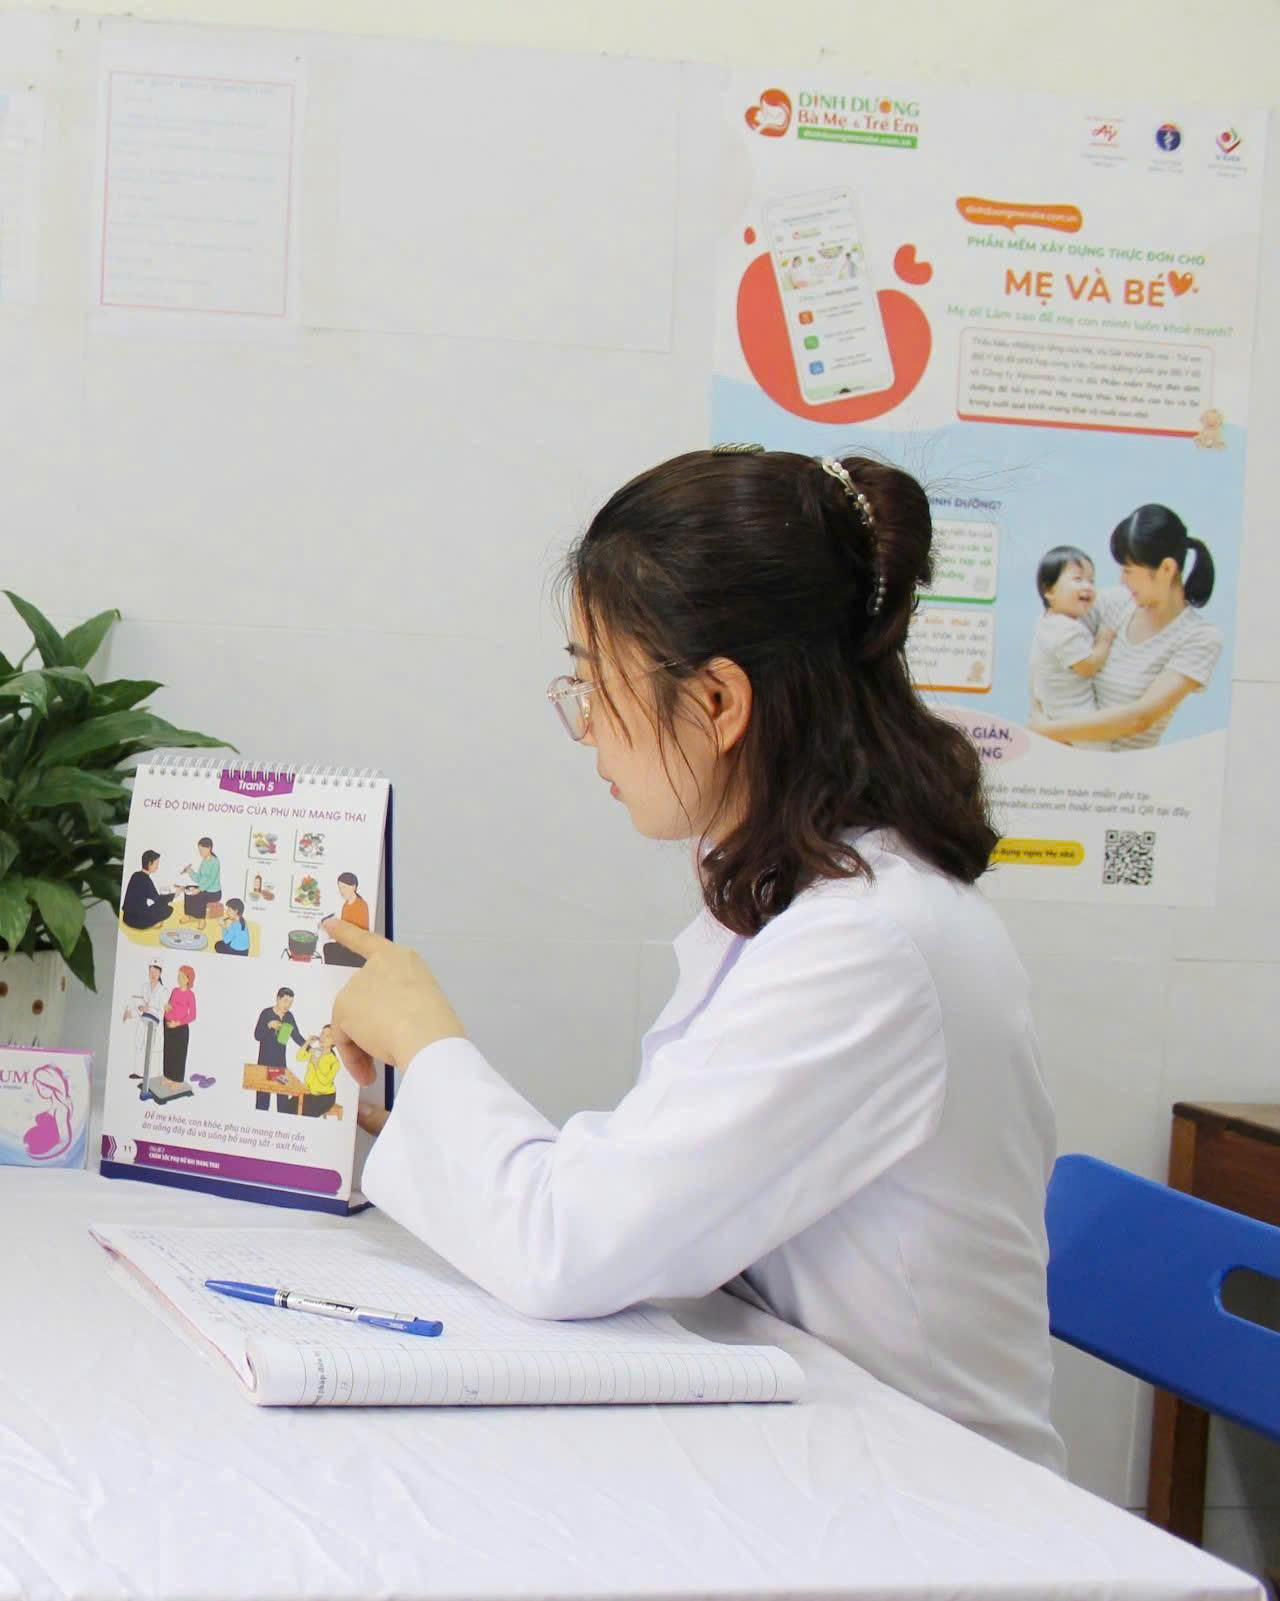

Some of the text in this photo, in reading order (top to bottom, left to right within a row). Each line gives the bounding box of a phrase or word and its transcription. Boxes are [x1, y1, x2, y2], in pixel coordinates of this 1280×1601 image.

[799, 92, 846, 109] DINH
[798, 109, 818, 125] Bà
[823, 112, 847, 129] Mẹ
[894, 118, 919, 134] Em
[1004, 267, 1166, 308] MẸ VÀ BÉ
[238, 779, 274, 791] Tranh 5
[143, 796, 162, 808] CHẾ
[164, 798, 179, 811] ĐỘ
[181, 801, 205, 811] DINH
[207, 801, 244, 814] DƯỠNG
[246, 802, 268, 816] CỦA
[270, 807, 289, 819] PHỤ
[308, 809, 341, 821] MANG
[344, 812, 367, 823] THAI
[152, 1123, 170, 1135] uống
[172, 1125, 185, 1137] đầy
[198, 1129, 207, 1138] và
[207, 1130, 226, 1143] uống
[238, 1136, 257, 1148] sung
[275, 1139, 290, 1149] axit
[291, 1141, 308, 1153] folic
[188, 1118, 201, 1126] con
[224, 1122, 238, 1133] phụ
[251, 1128, 273, 1139] mang
[274, 1128, 290, 1138] thai
[291, 1131, 305, 1142] cần
